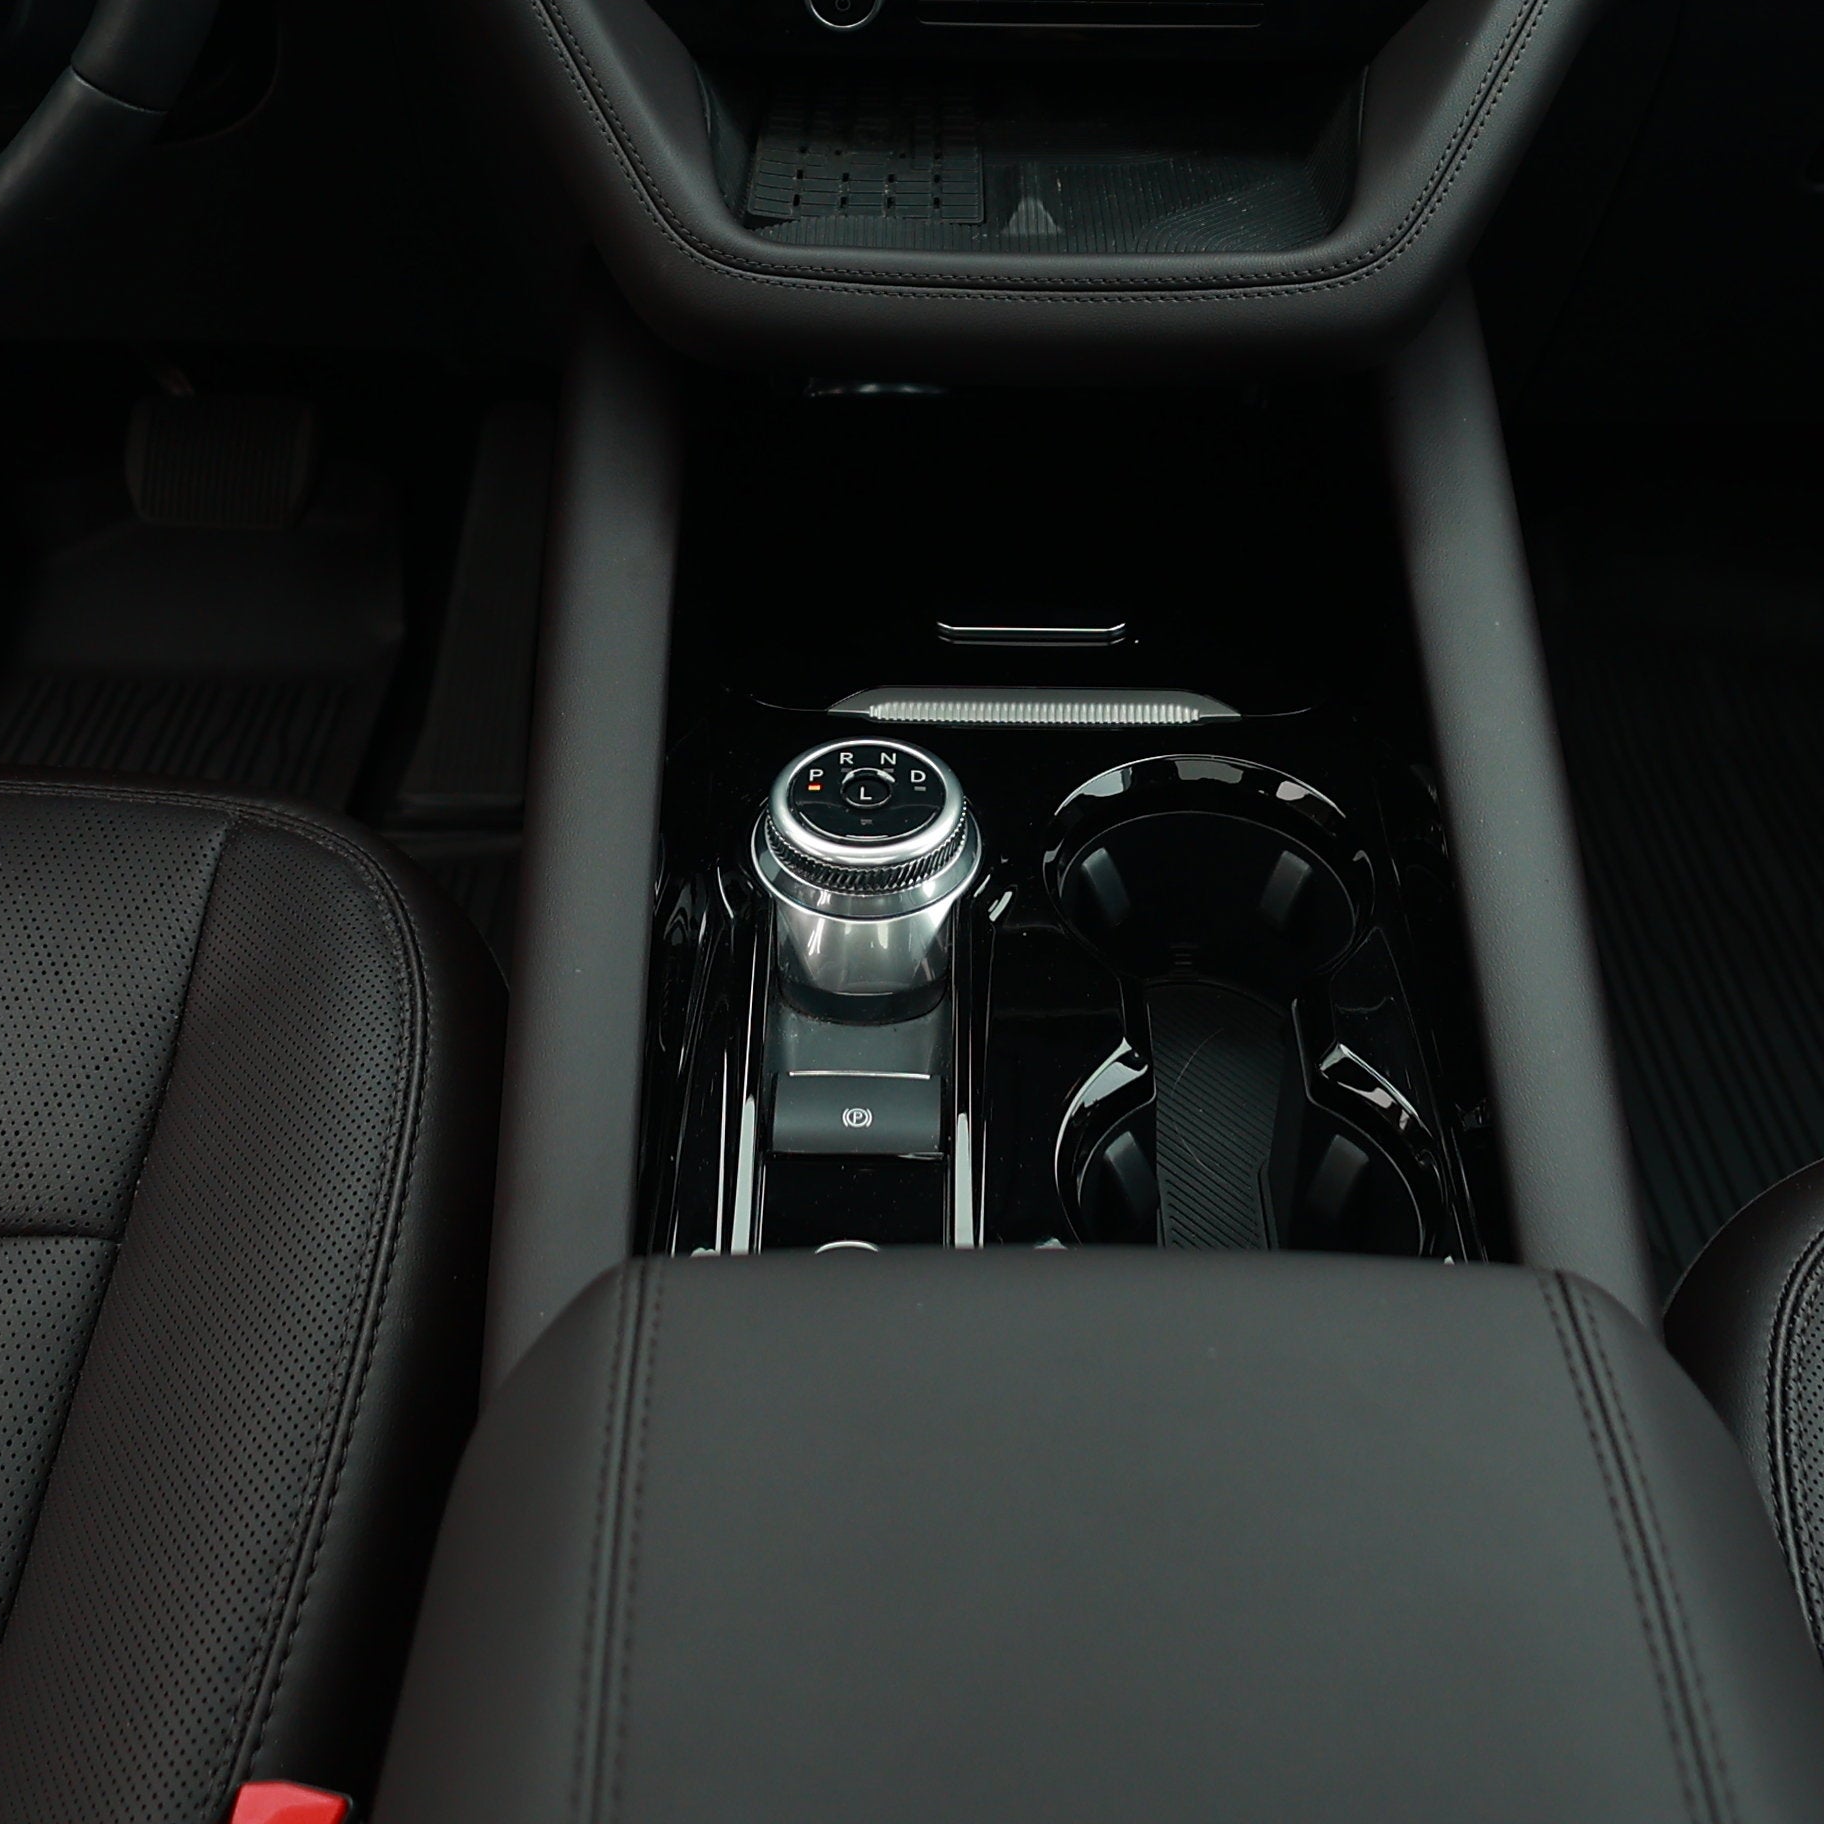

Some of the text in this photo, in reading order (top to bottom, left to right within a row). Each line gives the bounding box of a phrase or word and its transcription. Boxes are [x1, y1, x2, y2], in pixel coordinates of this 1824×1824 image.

[839, 752, 897, 765] R N
[809, 768, 824, 782] P
[910, 769, 926, 783] D
[859, 786, 872, 800] L
